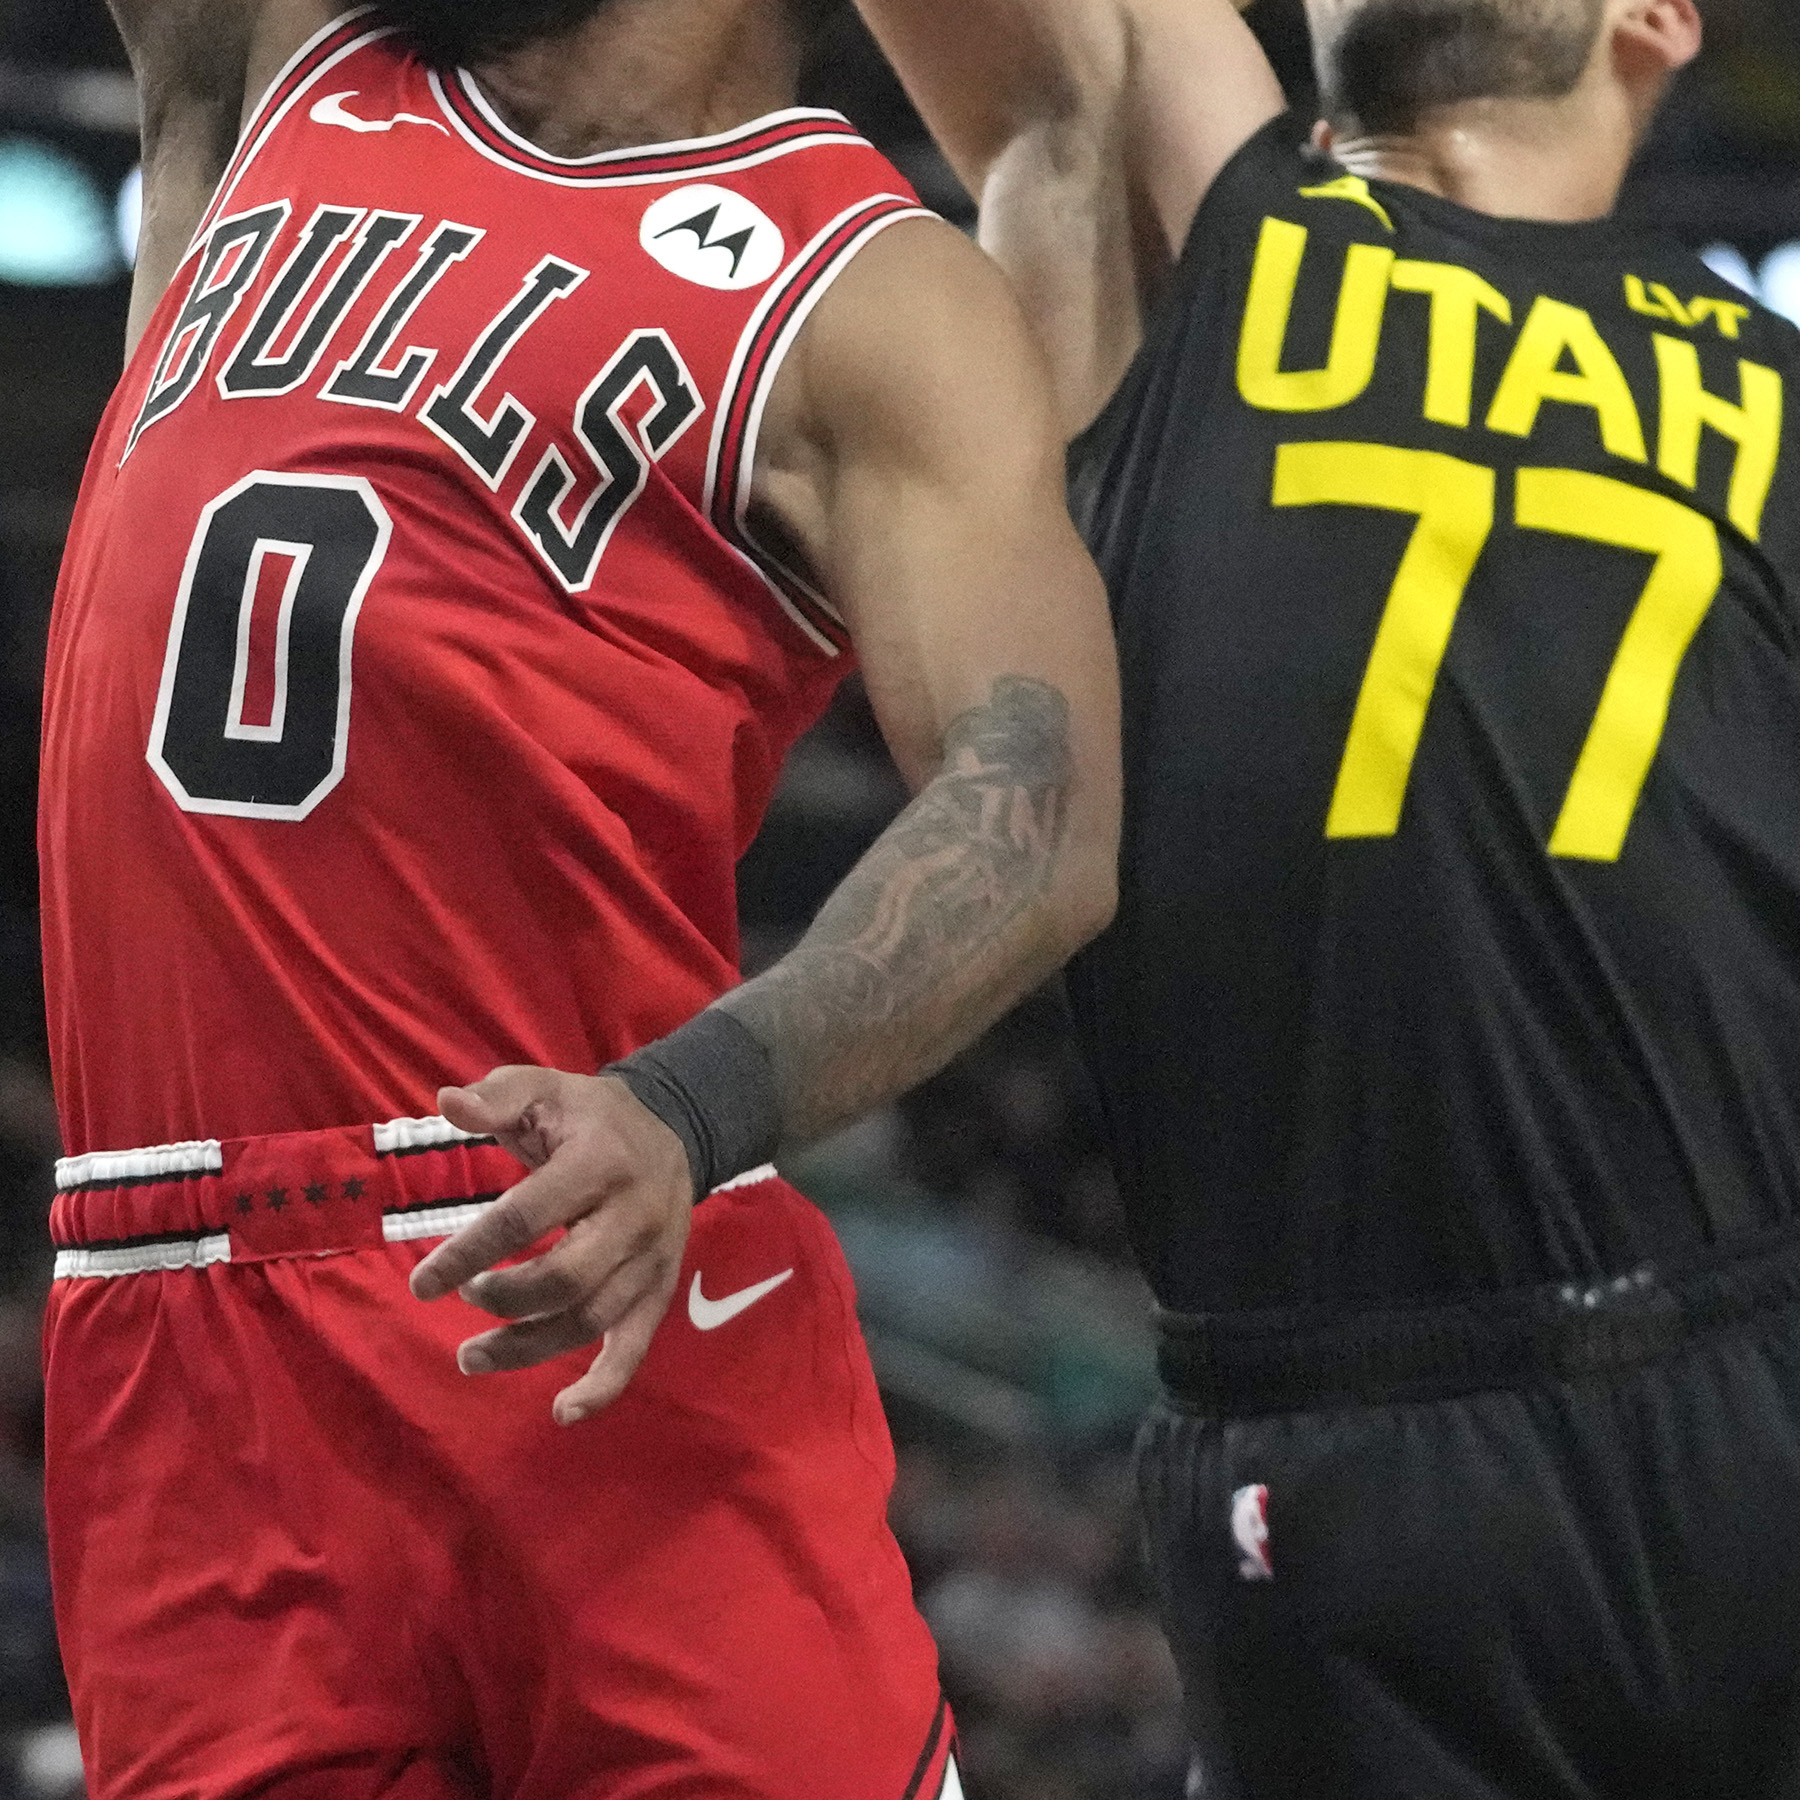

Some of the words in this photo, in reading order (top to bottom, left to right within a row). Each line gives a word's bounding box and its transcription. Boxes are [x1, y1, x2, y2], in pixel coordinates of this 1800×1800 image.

[117, 198, 706, 593] BULLS
[1236, 216, 1784, 544] UTAH
[1623, 273, 1750, 340] LVT
[146, 469, 394, 822] 0
[1272, 441, 1723, 864] 77
